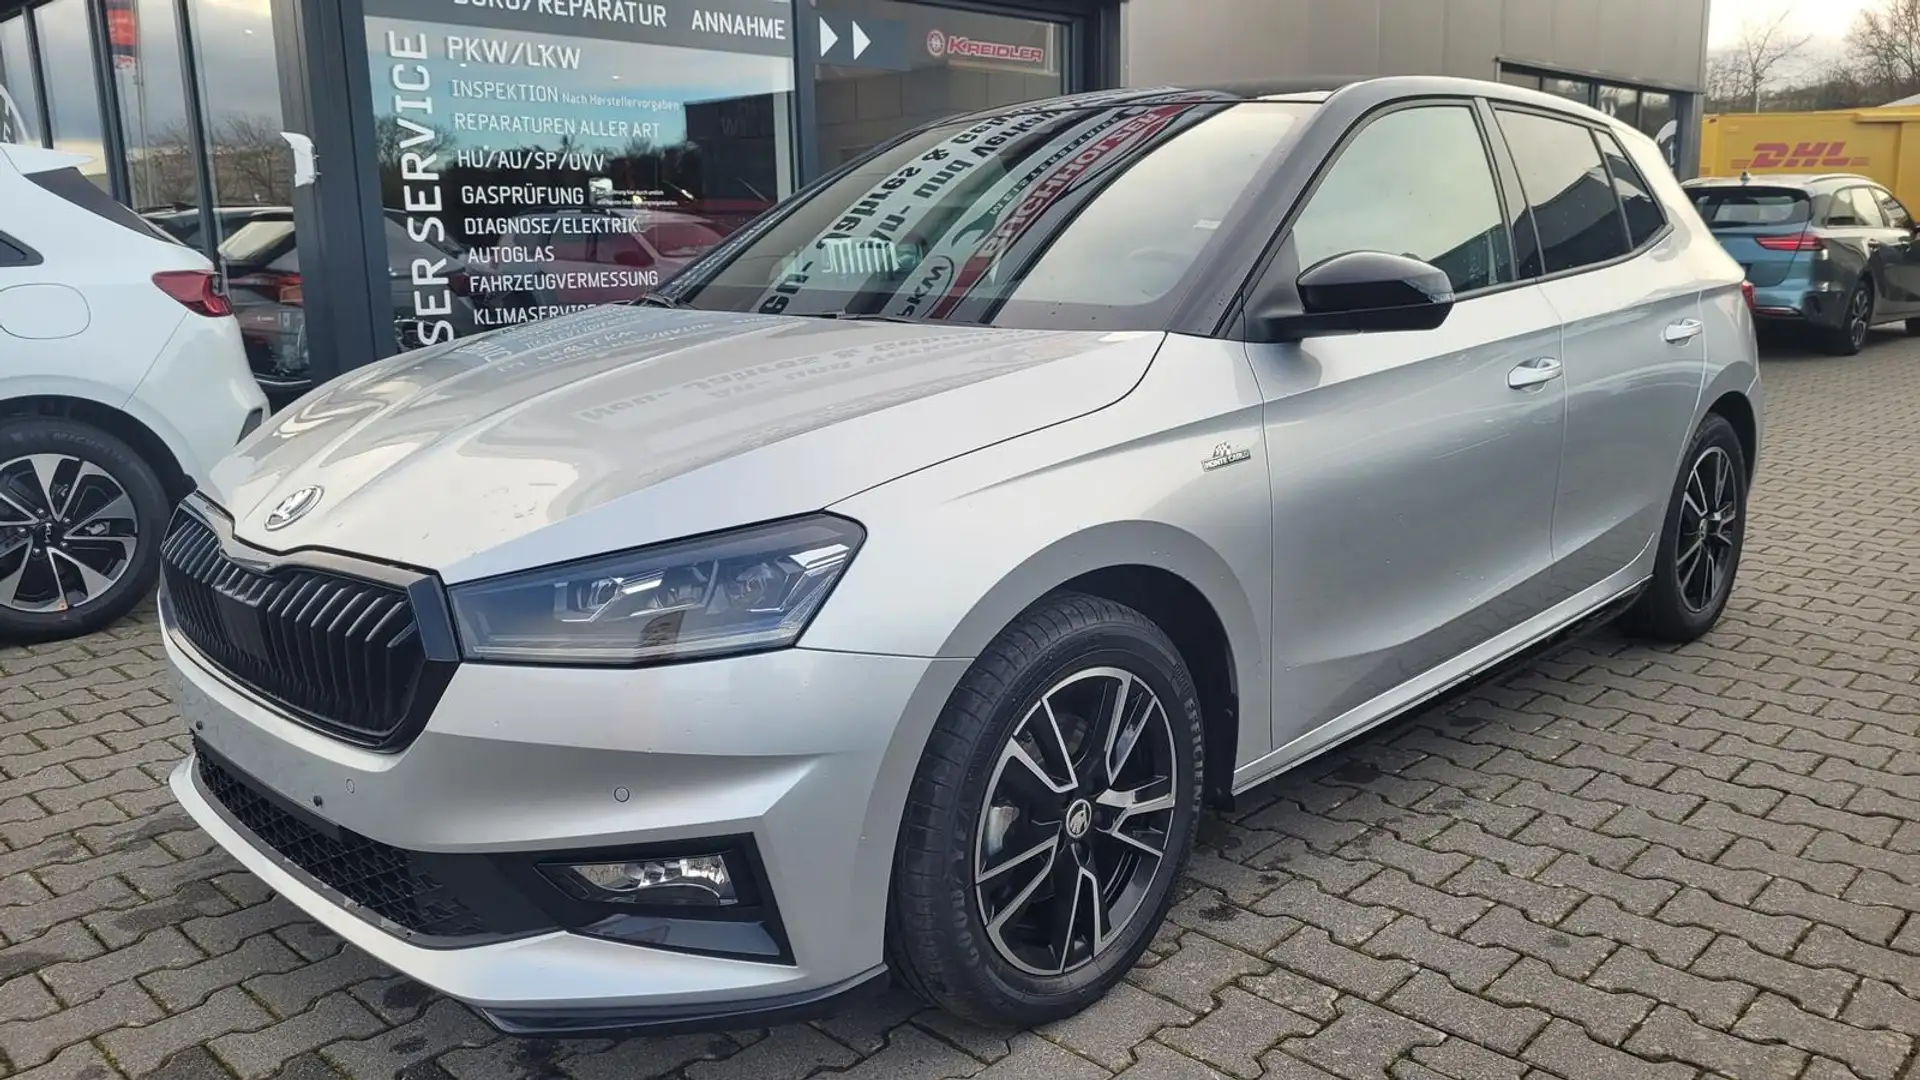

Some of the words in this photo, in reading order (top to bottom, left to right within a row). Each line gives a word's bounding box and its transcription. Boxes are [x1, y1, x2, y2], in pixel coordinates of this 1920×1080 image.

[691, 10, 786, 40] ANNAHME
[447, 36, 581, 70] PKW/LKW
[947, 36, 1044, 63] KREIDLER
[452, 79, 559, 103] INSPEKTION
[562, 92, 588, 105] Nach
[589, 94, 680, 112] Herstellervorgaben
[388, 30, 445, 243] SERVICE
[454, 112, 576, 135] REPARATUREN
[580, 119, 628, 137] ALLER
[632, 121, 661, 138] ART
[458, 149, 605, 172] HU/AU/SP/UVV
[1751, 141, 1852, 168] DHL
[461, 183, 585, 205] GASPRÜFUNG
[464, 216, 638, 235] DIAGNOSE/ELEKTRIK
[468, 246, 555, 264] AUTOGLAS
[469, 270, 659, 292] FAHRZEUGVERMESSUNG
